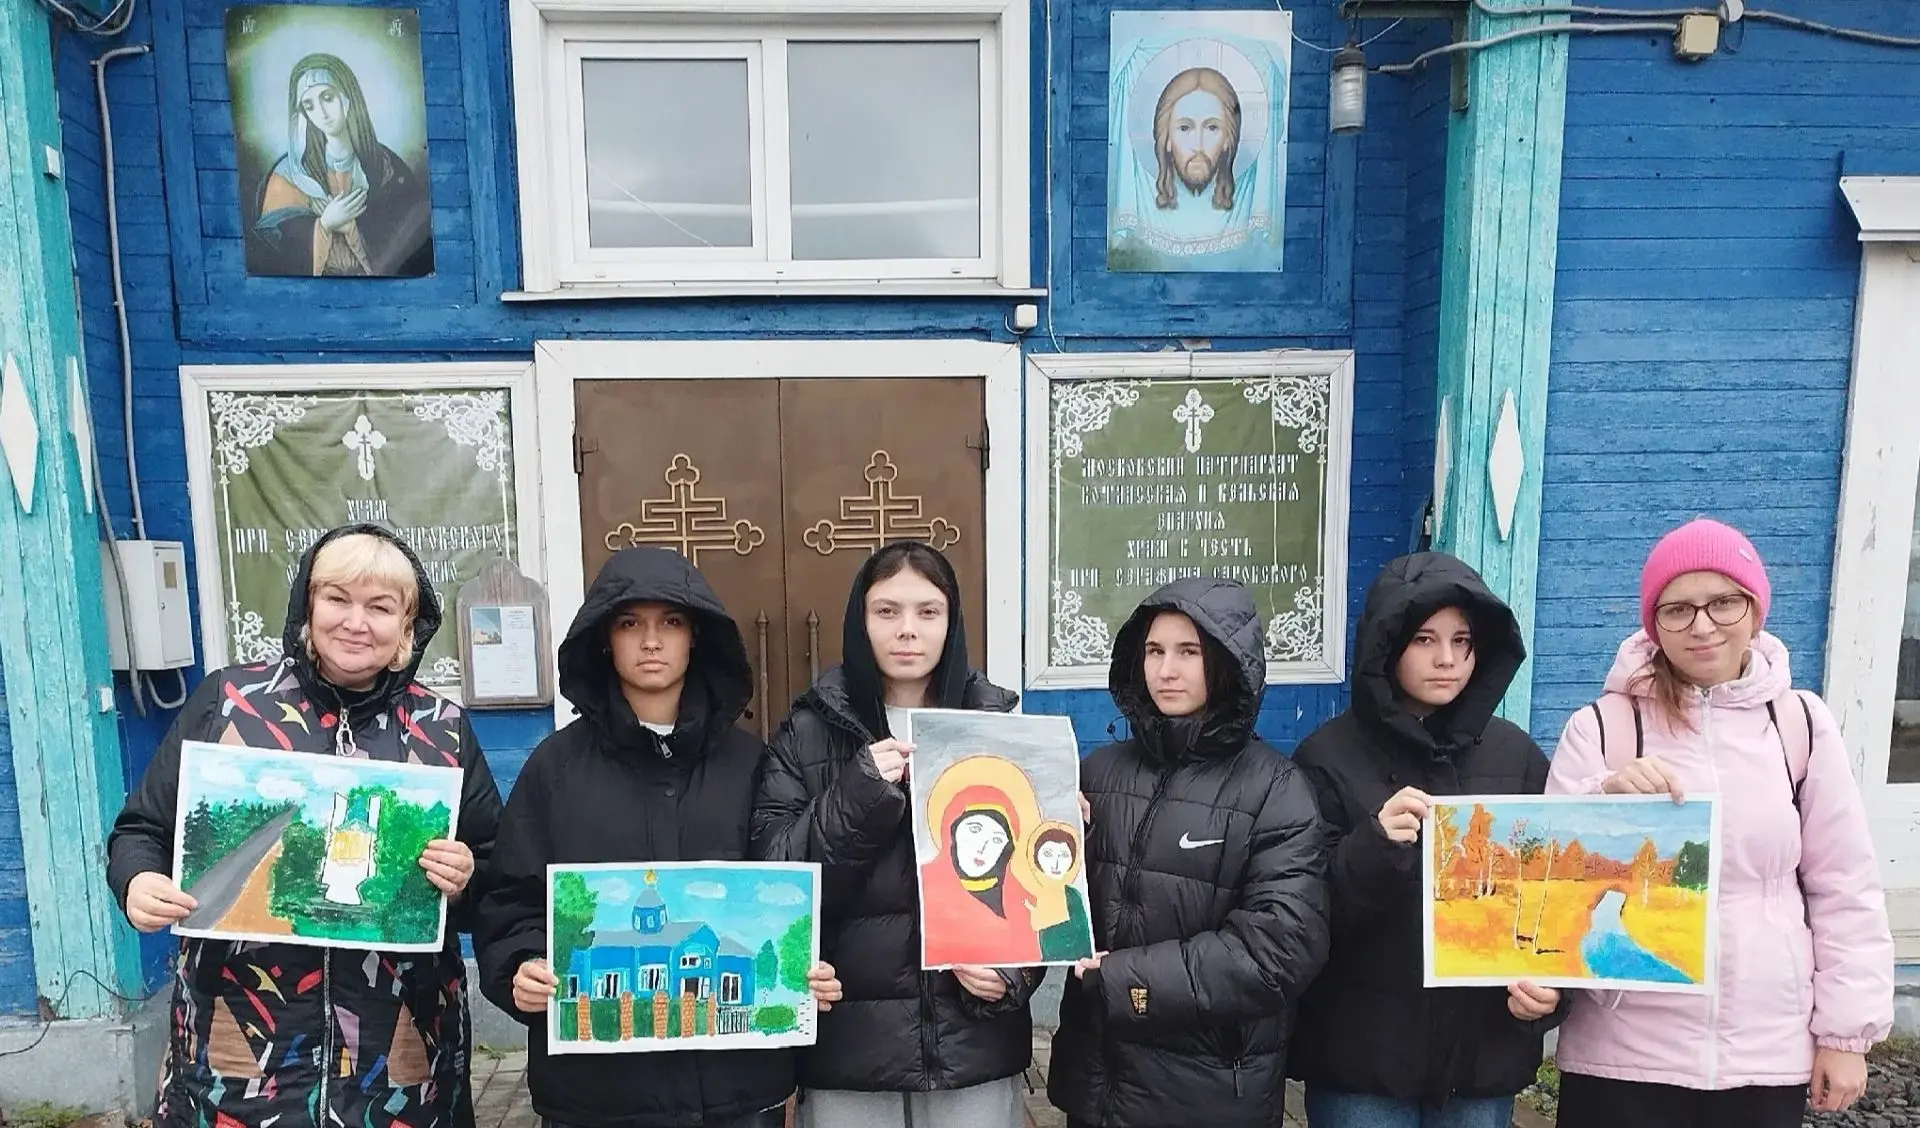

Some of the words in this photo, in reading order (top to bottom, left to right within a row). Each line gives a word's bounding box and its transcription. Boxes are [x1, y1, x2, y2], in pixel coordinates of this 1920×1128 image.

[1196, 454, 1299, 475] ПАТРИАРХАТ
[1198, 483, 1207, 503] И
[1218, 481, 1299, 502] ВЕЛЬСКАЯ
[347, 499, 388, 521] ХРАМ
[1157, 511, 1225, 531] ЕПАРХИЯ
[235, 528, 274, 554] ПРП.
[1127, 539, 1169, 558] ХРАМ
[1180, 538, 1188, 557] В
[1200, 537, 1252, 557] ЧЕСТЬ
[1070, 567, 1104, 588] ПРП.
